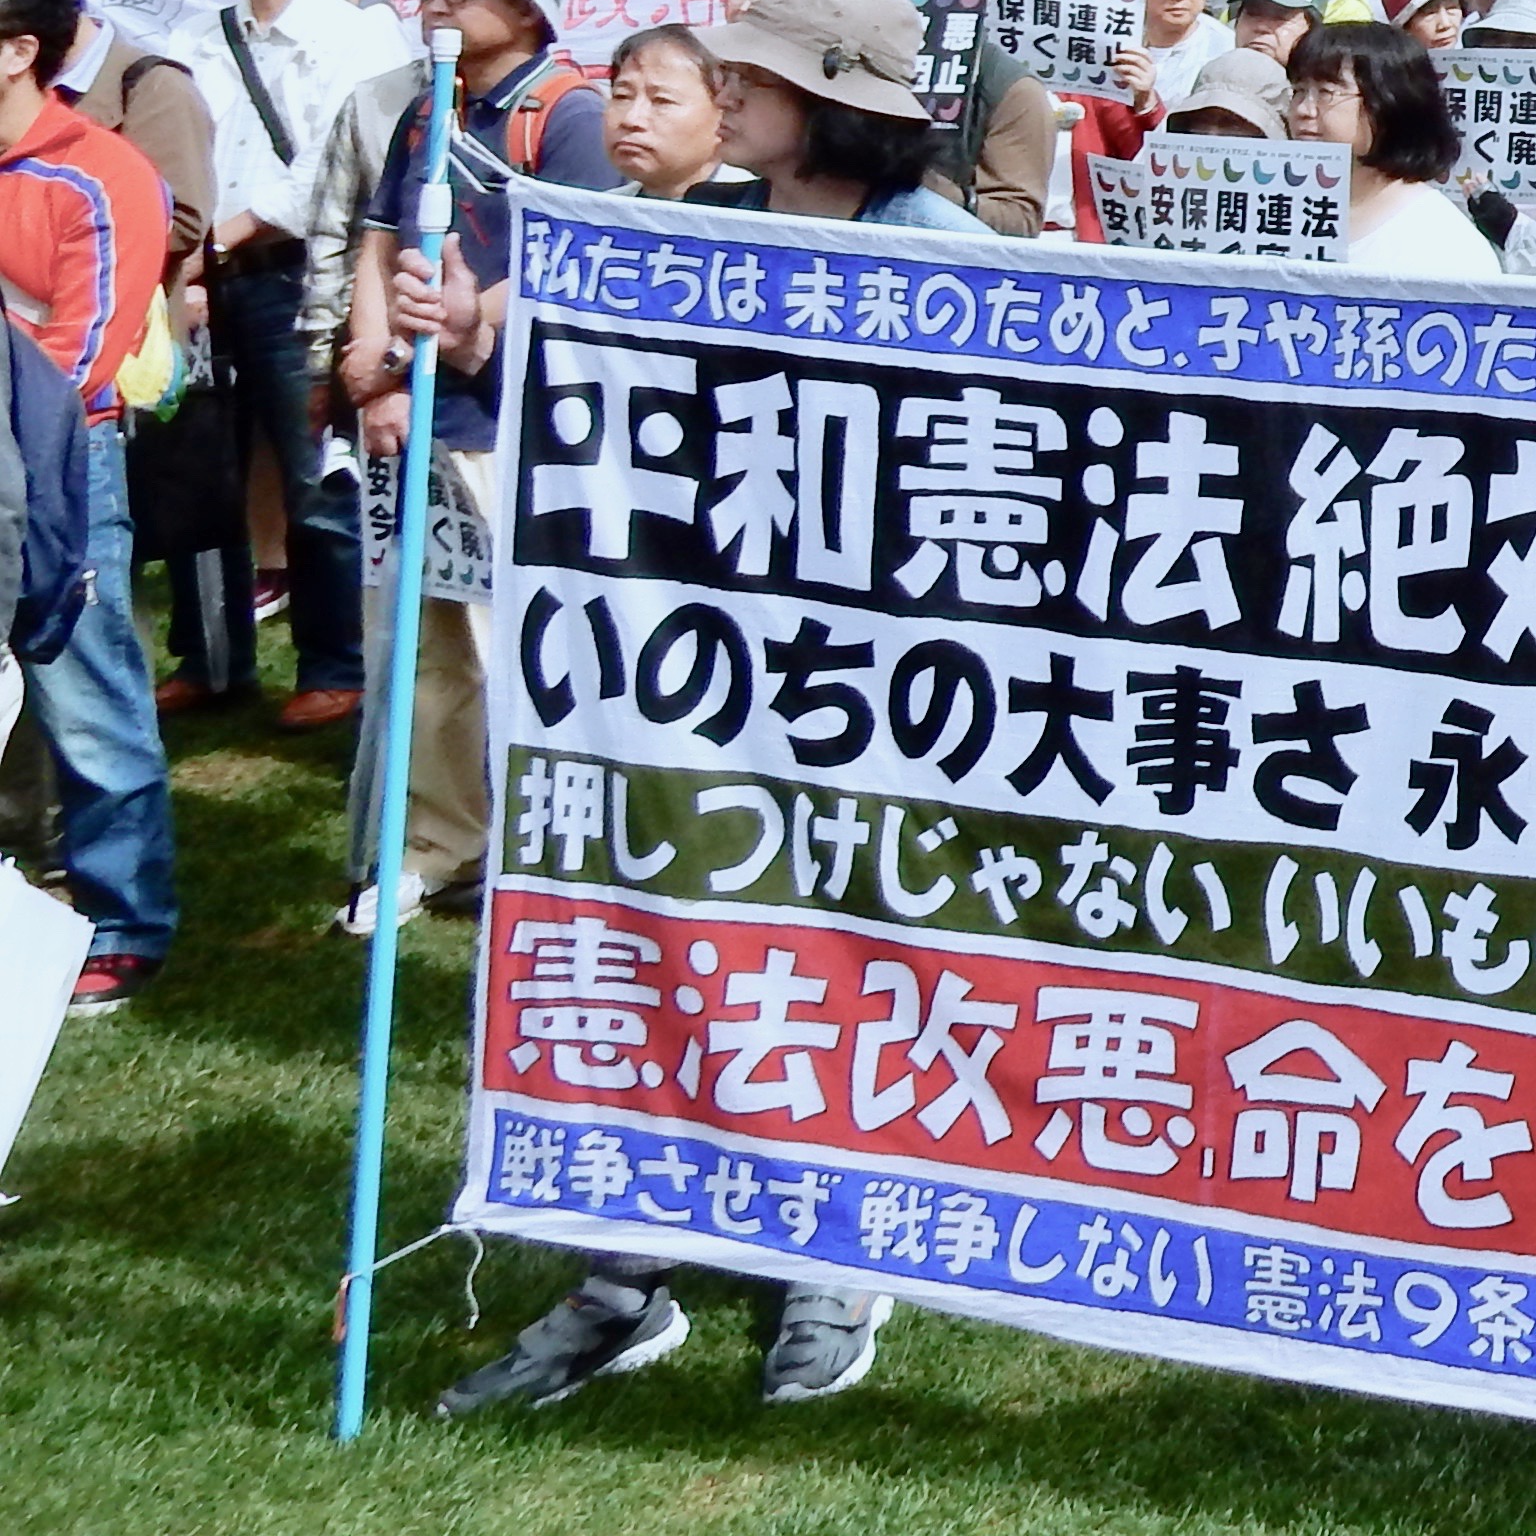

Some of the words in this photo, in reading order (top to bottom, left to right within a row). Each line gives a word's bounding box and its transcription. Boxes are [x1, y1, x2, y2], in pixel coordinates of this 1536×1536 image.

[996, 25, 1124, 67] すぐ廃止
[1151, 183, 1340, 241] 安保関連法
[524, 220, 764, 323] 私たちは
[520, 583, 1370, 831] いのちの大事さ
[500, 1120, 841, 1246] 戦争させず
[859, 1177, 1213, 1309] 戦争しない
